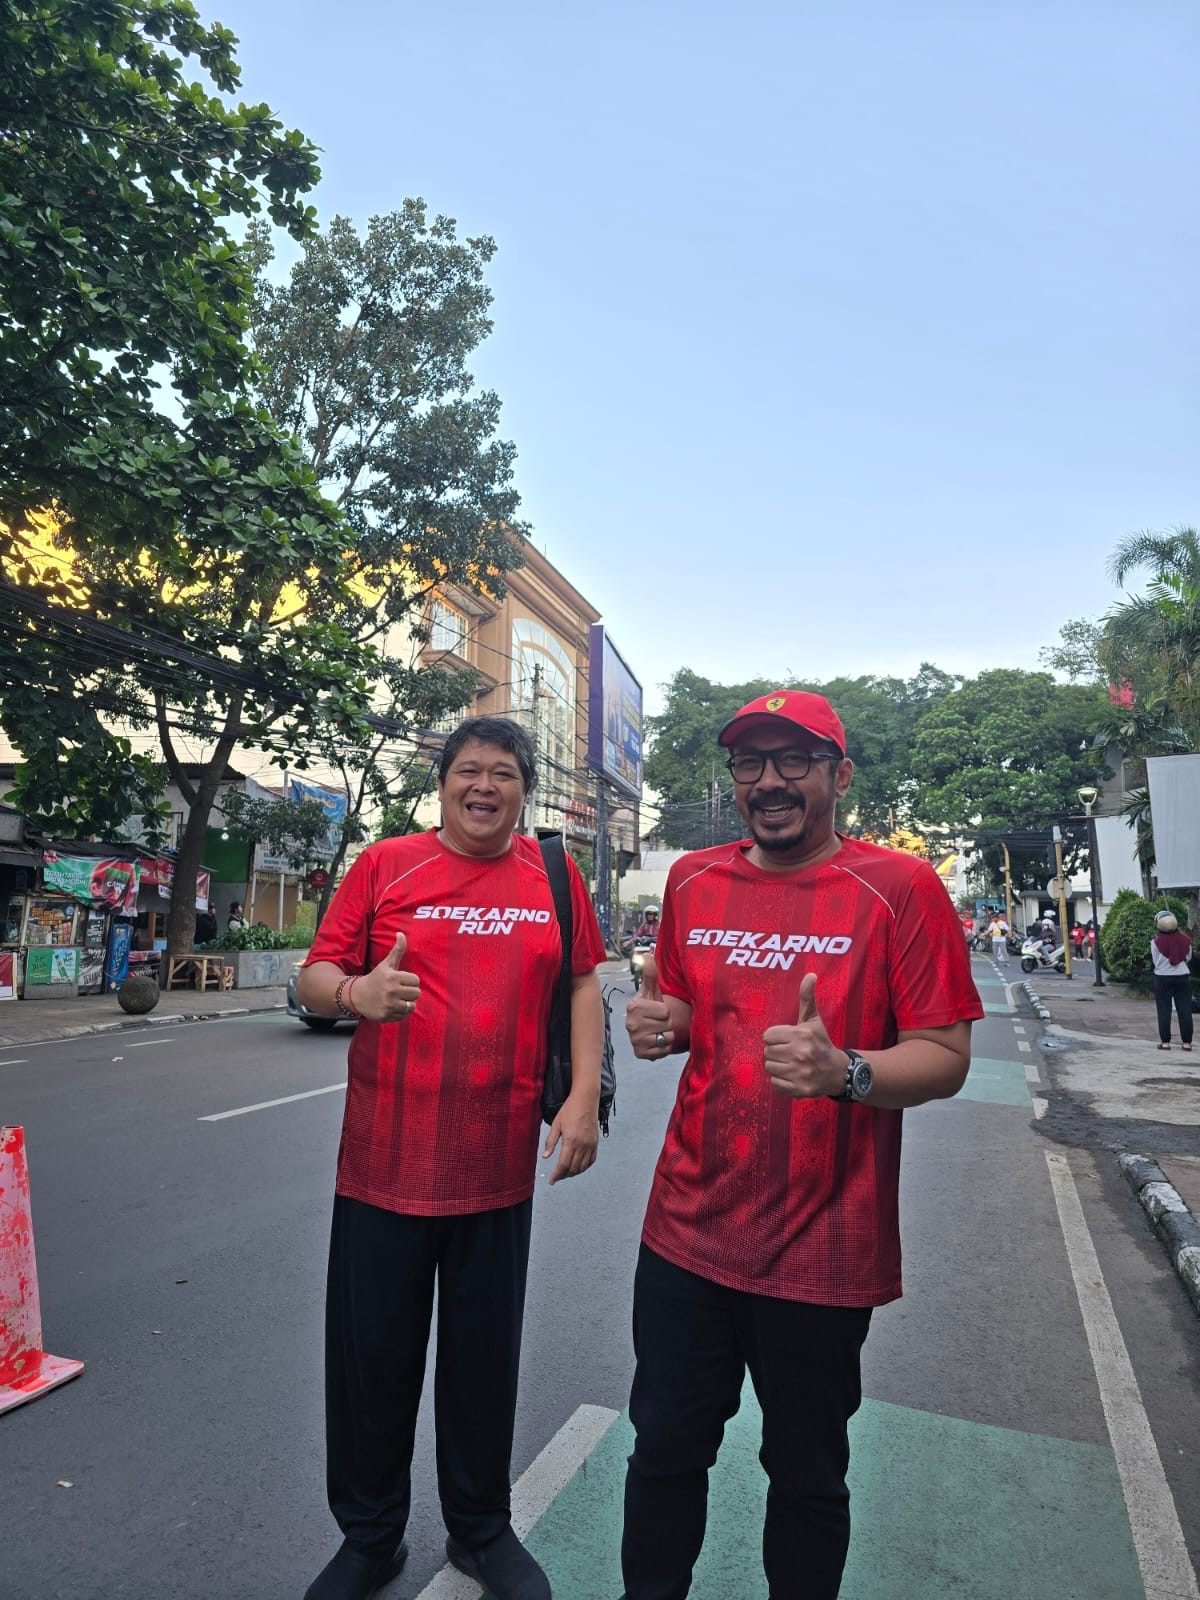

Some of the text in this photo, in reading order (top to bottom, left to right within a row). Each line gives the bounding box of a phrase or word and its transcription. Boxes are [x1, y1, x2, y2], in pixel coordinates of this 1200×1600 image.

[413, 906, 550, 923] SOEKARNO
[457, 921, 514, 935] RUN
[686, 928, 852, 955] SOEKARNO
[725, 948, 796, 970] RUN
